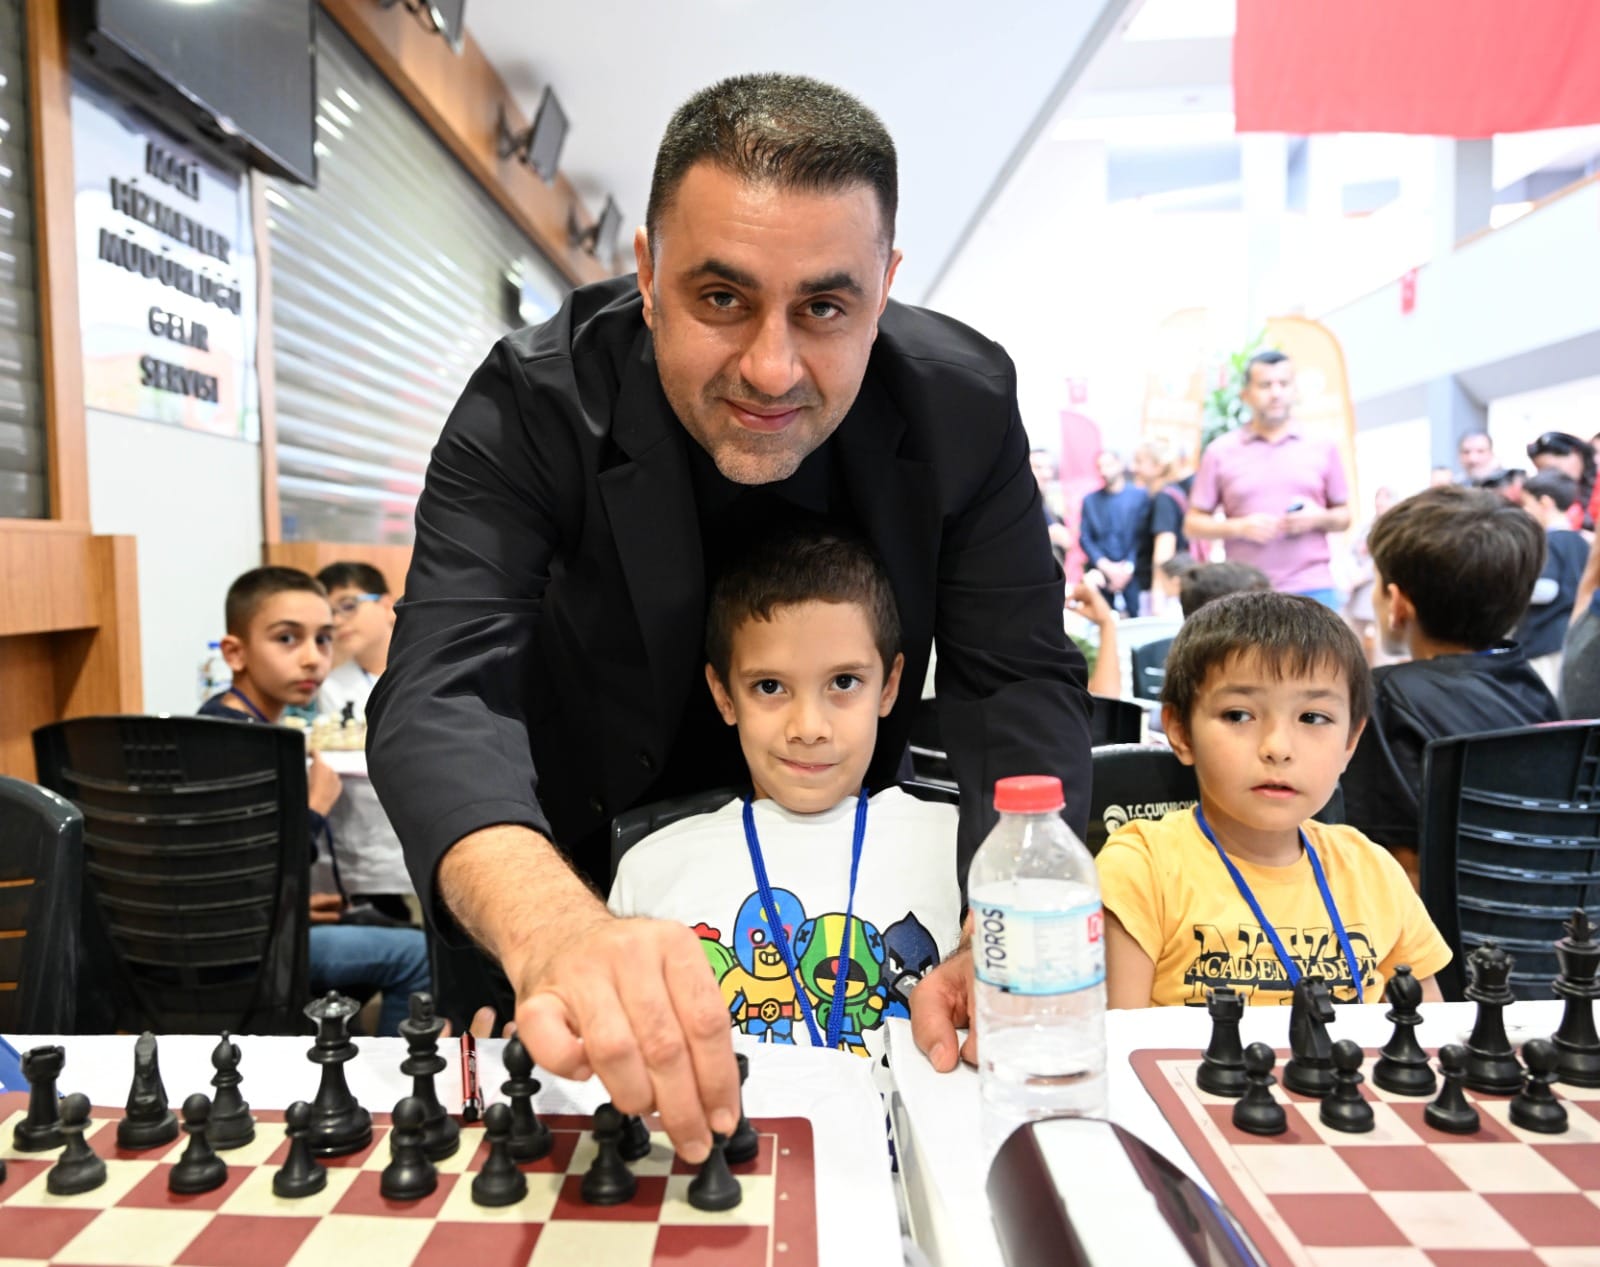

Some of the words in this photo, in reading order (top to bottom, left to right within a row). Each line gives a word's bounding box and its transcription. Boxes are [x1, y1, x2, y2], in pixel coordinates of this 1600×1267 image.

[145, 141, 200, 202] MALİ
[110, 177, 230, 265] HİZMETLER
[982, 908, 1007, 969] TOROS
